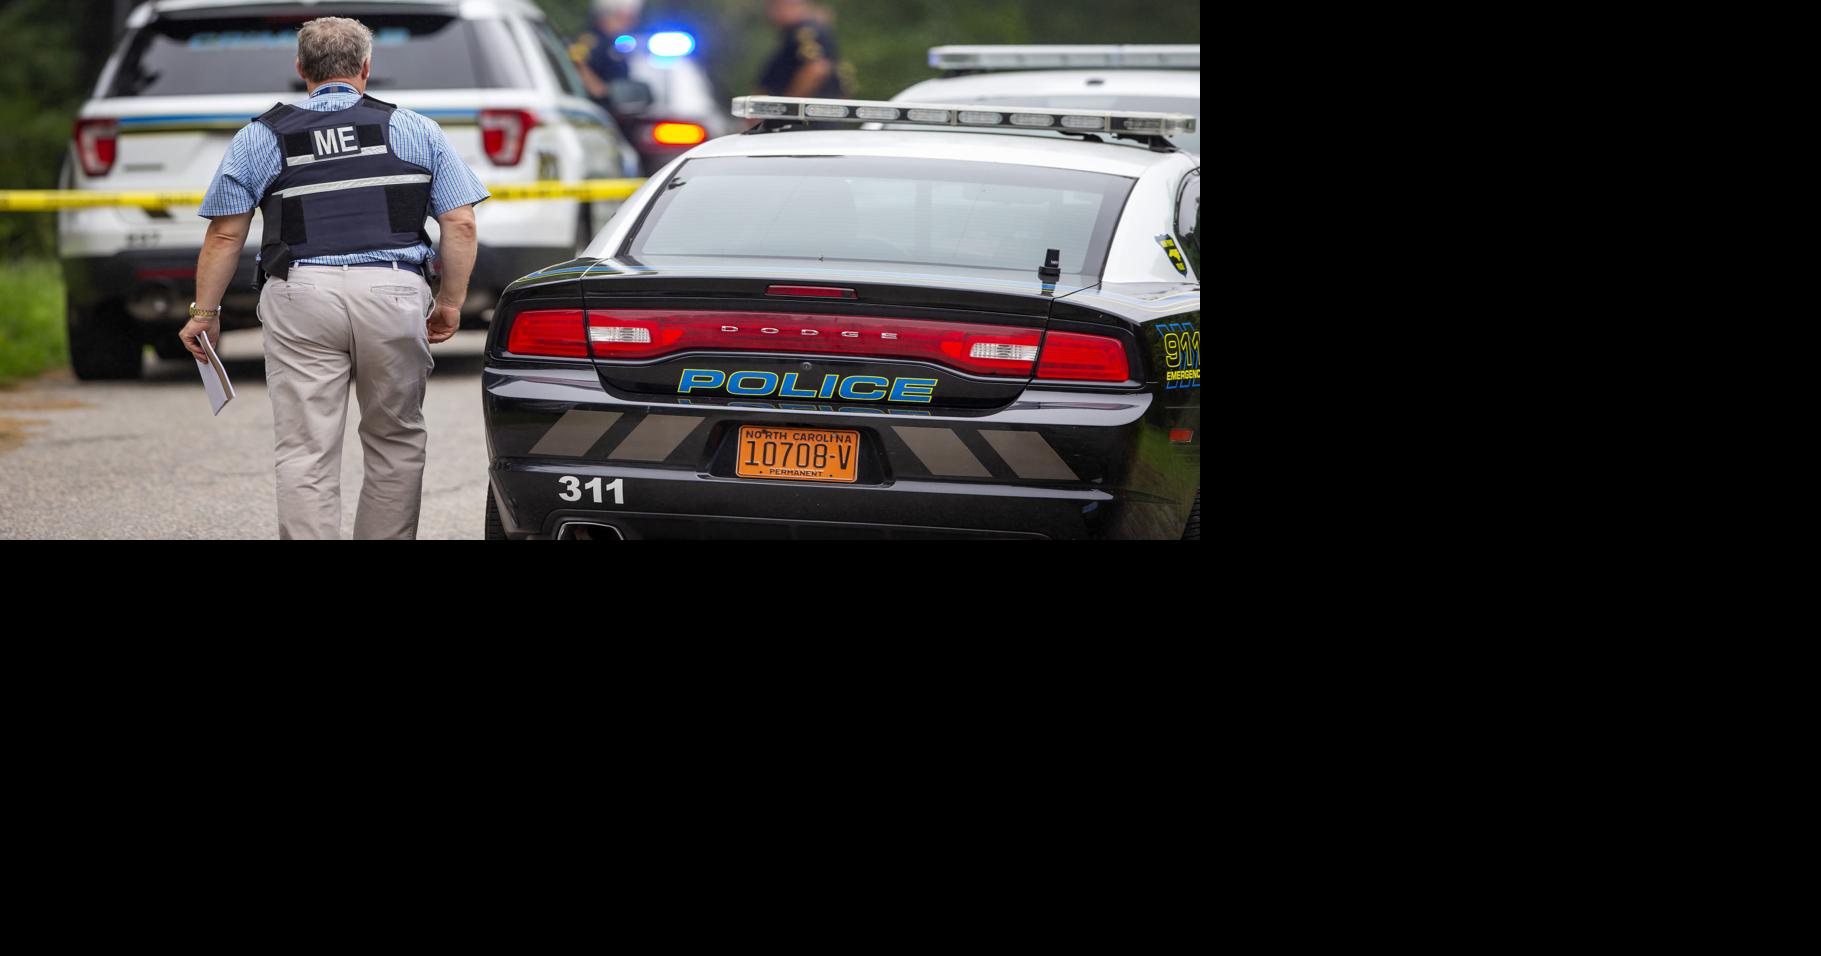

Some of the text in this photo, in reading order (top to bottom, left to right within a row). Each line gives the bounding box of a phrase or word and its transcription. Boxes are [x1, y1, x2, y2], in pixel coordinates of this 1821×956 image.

[313, 126, 358, 156] ME
[721, 325, 898, 340] DODGE
[1164, 331, 1200, 368] 911
[677, 368, 938, 403] POLICE
[745, 430, 852, 444] NORTH CAROLINA
[744, 440, 852, 470] 10708-V
[769, 468, 823, 477] PERMANENT
[558, 475, 624, 504] 311
